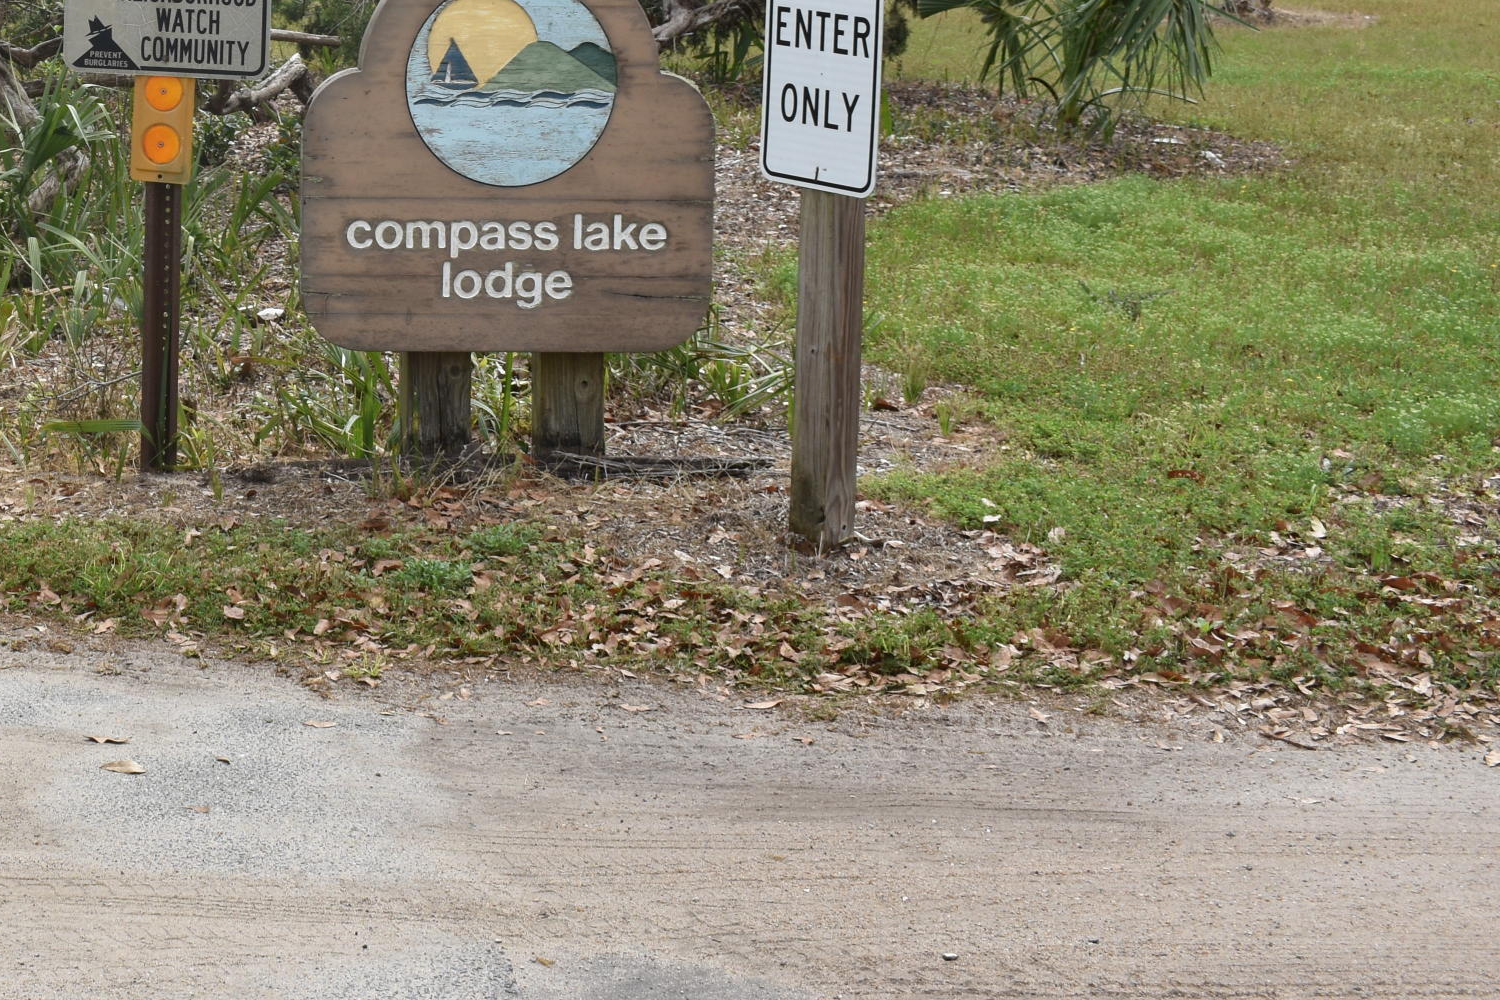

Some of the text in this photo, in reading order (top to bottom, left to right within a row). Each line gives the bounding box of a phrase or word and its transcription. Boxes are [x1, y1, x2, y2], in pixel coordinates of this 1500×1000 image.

[156, 8, 220, 35] WATCH
[776, 6, 870, 58] ENTER
[84, 59, 128, 68] BURGLARIES
[89, 50, 122, 59] PREVENT
[141, 36, 249, 65] COMMUNITY
[781, 83, 860, 133] ONLY
[346, 214, 668, 258] compass lake
[442, 262, 573, 310] lodge
